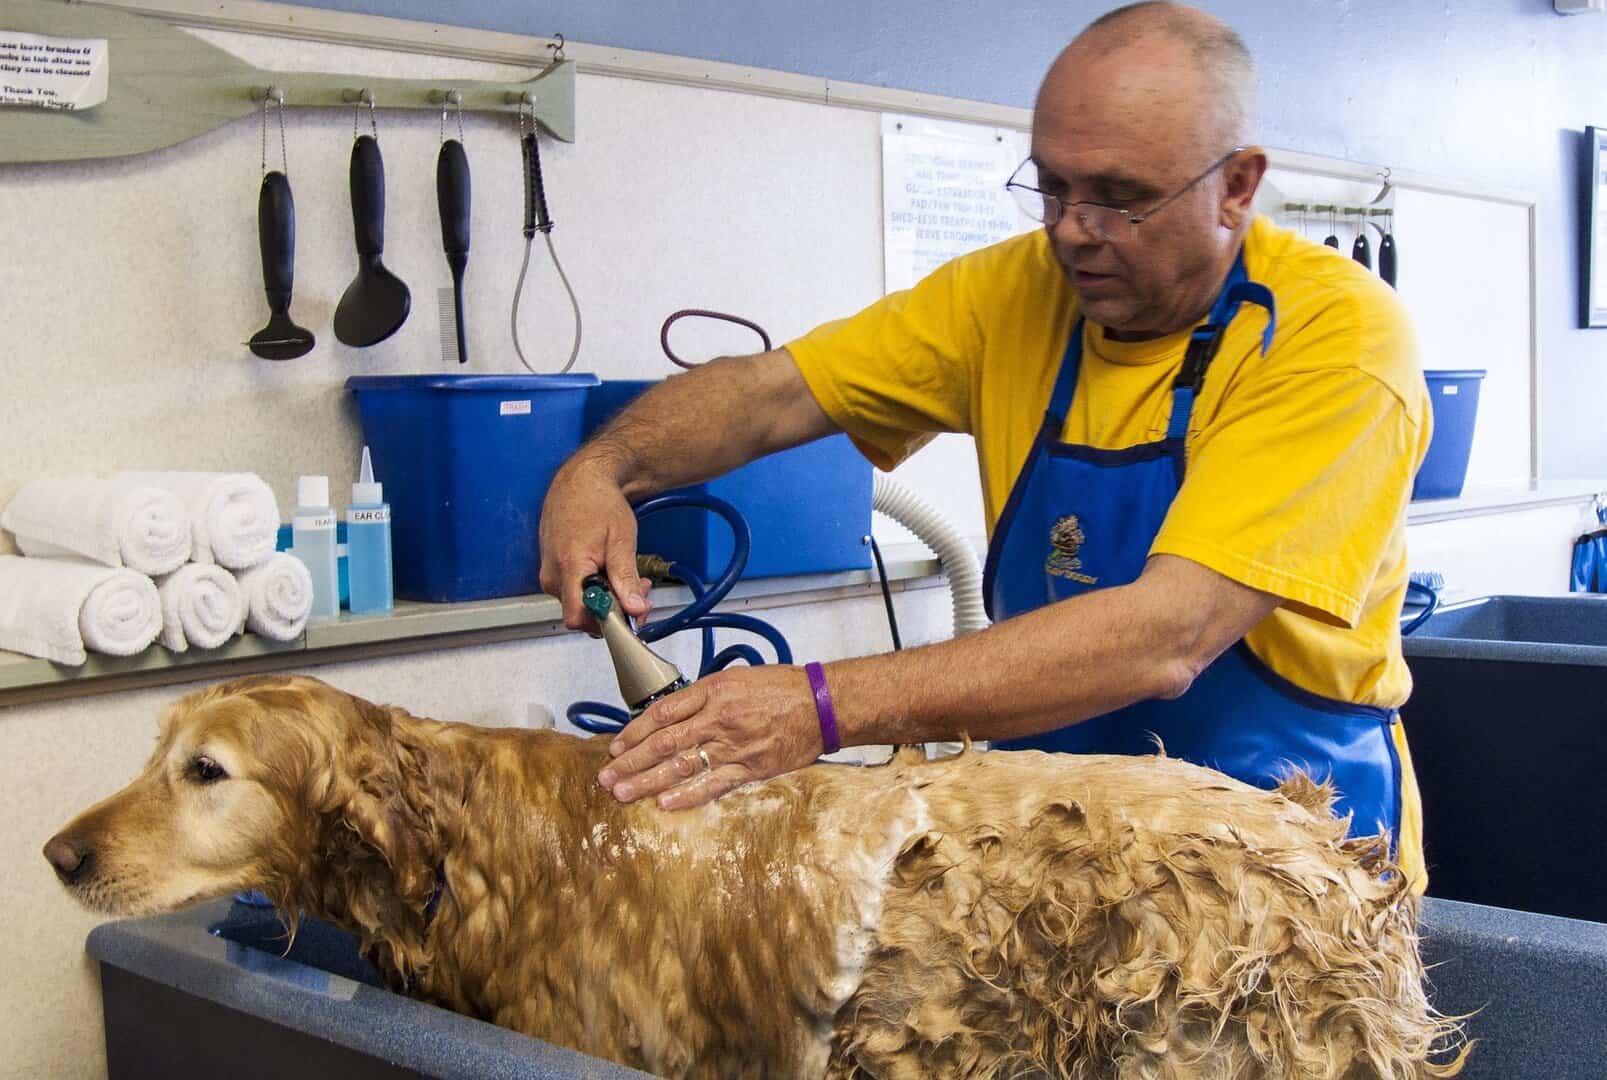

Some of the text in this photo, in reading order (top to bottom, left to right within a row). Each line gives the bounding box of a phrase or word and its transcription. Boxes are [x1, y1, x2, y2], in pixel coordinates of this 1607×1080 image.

[20, 43, 43, 51] leave
[46, 45, 81, 54] brushes
[33, 55, 49, 63] tub
[51, 57, 73, 65] after
[0, 64, 22, 74] they
[43, 66, 54, 74] be
[56, 68, 91, 76] cleaned
[3, 86, 33, 94] Thank
[354, 511, 373, 521] EAR
